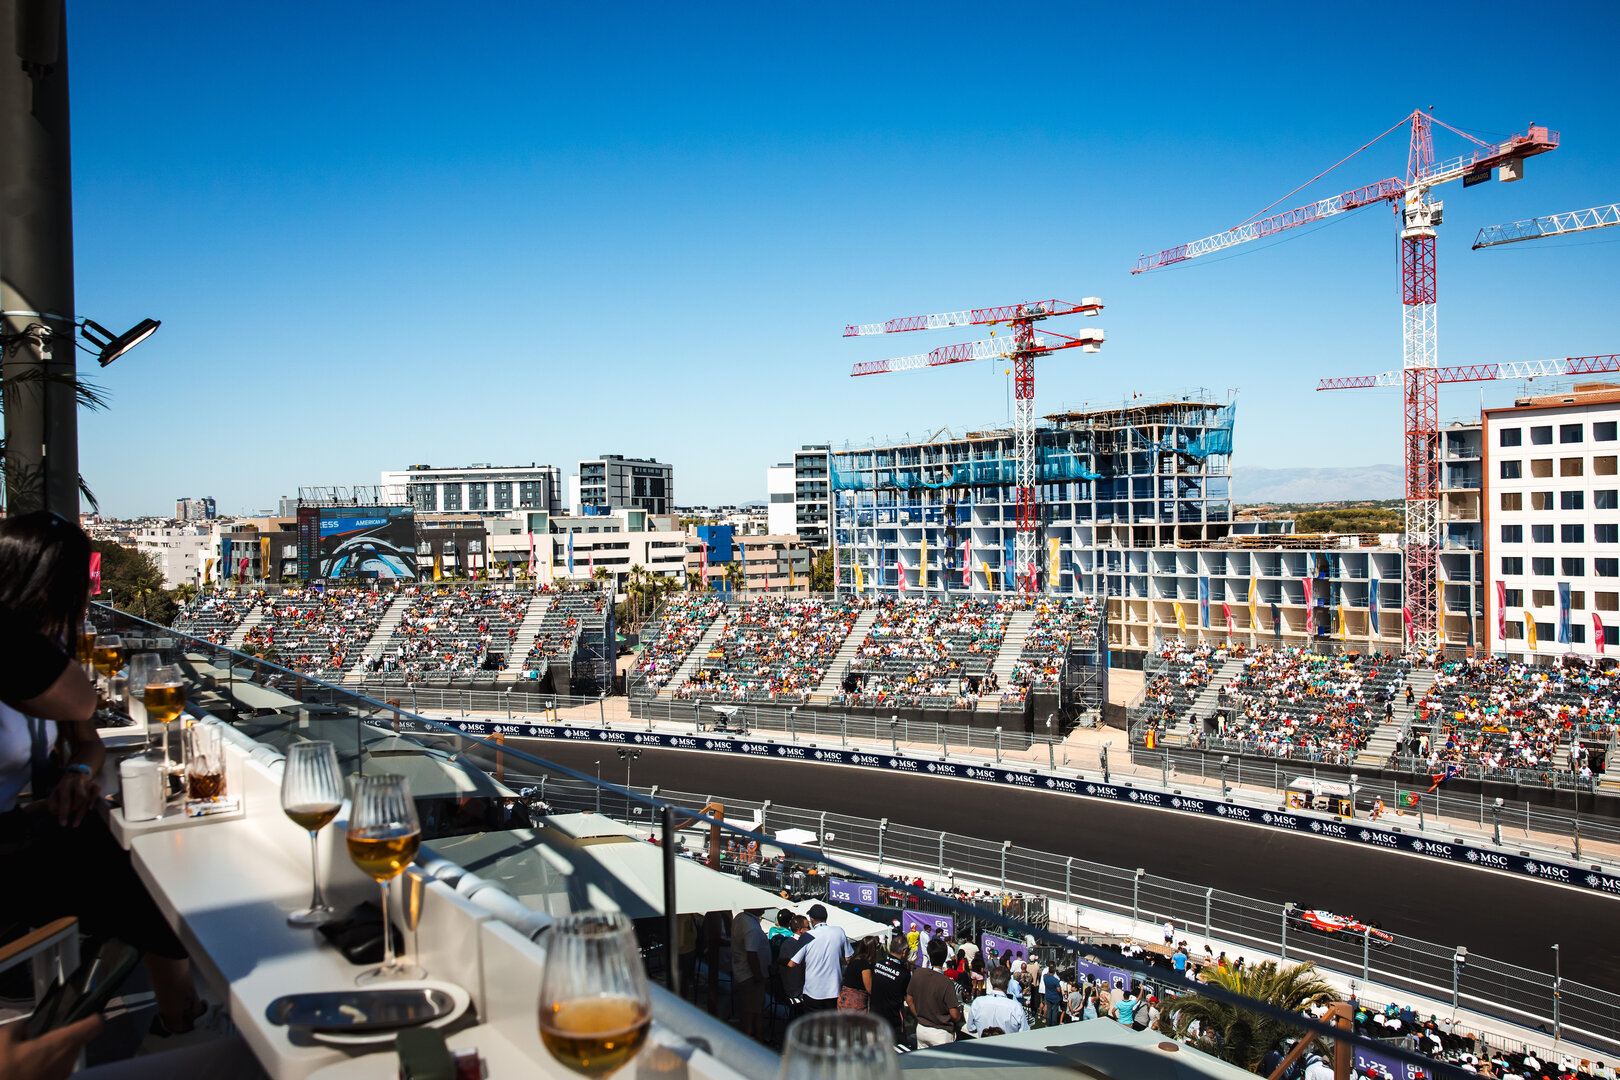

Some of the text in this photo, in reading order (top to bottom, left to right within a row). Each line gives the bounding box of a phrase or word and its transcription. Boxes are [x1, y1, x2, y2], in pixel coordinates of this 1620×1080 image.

[823, 752, 842, 760] MSC
[860, 755, 879, 763] MSC
[898, 760, 917, 768] MSC
[936, 764, 956, 772] MSC
[976, 769, 995, 778] MSC
[1015, 775, 1035, 783] MSC
[1056, 780, 1076, 789] MSC
[1096, 786, 1117, 795] MSC
[1139, 792, 1161, 802] MSC
[1182, 799, 1204, 809] MSC
[1228, 807, 1250, 817] MSC
[1273, 814, 1297, 825] MSC
[1322, 823, 1346, 835] MSC
[1372, 832, 1397, 844] MSC
[1425, 842, 1452, 855] MSC
[1480, 852, 1508, 866] MSC
[1539, 864, 1569, 878] MSC
[1601, 877, 1620, 890] MS
[935, 920, 948, 928] GD
[985, 939, 996, 948] GD
[1406, 1064, 1423, 1072] GD
